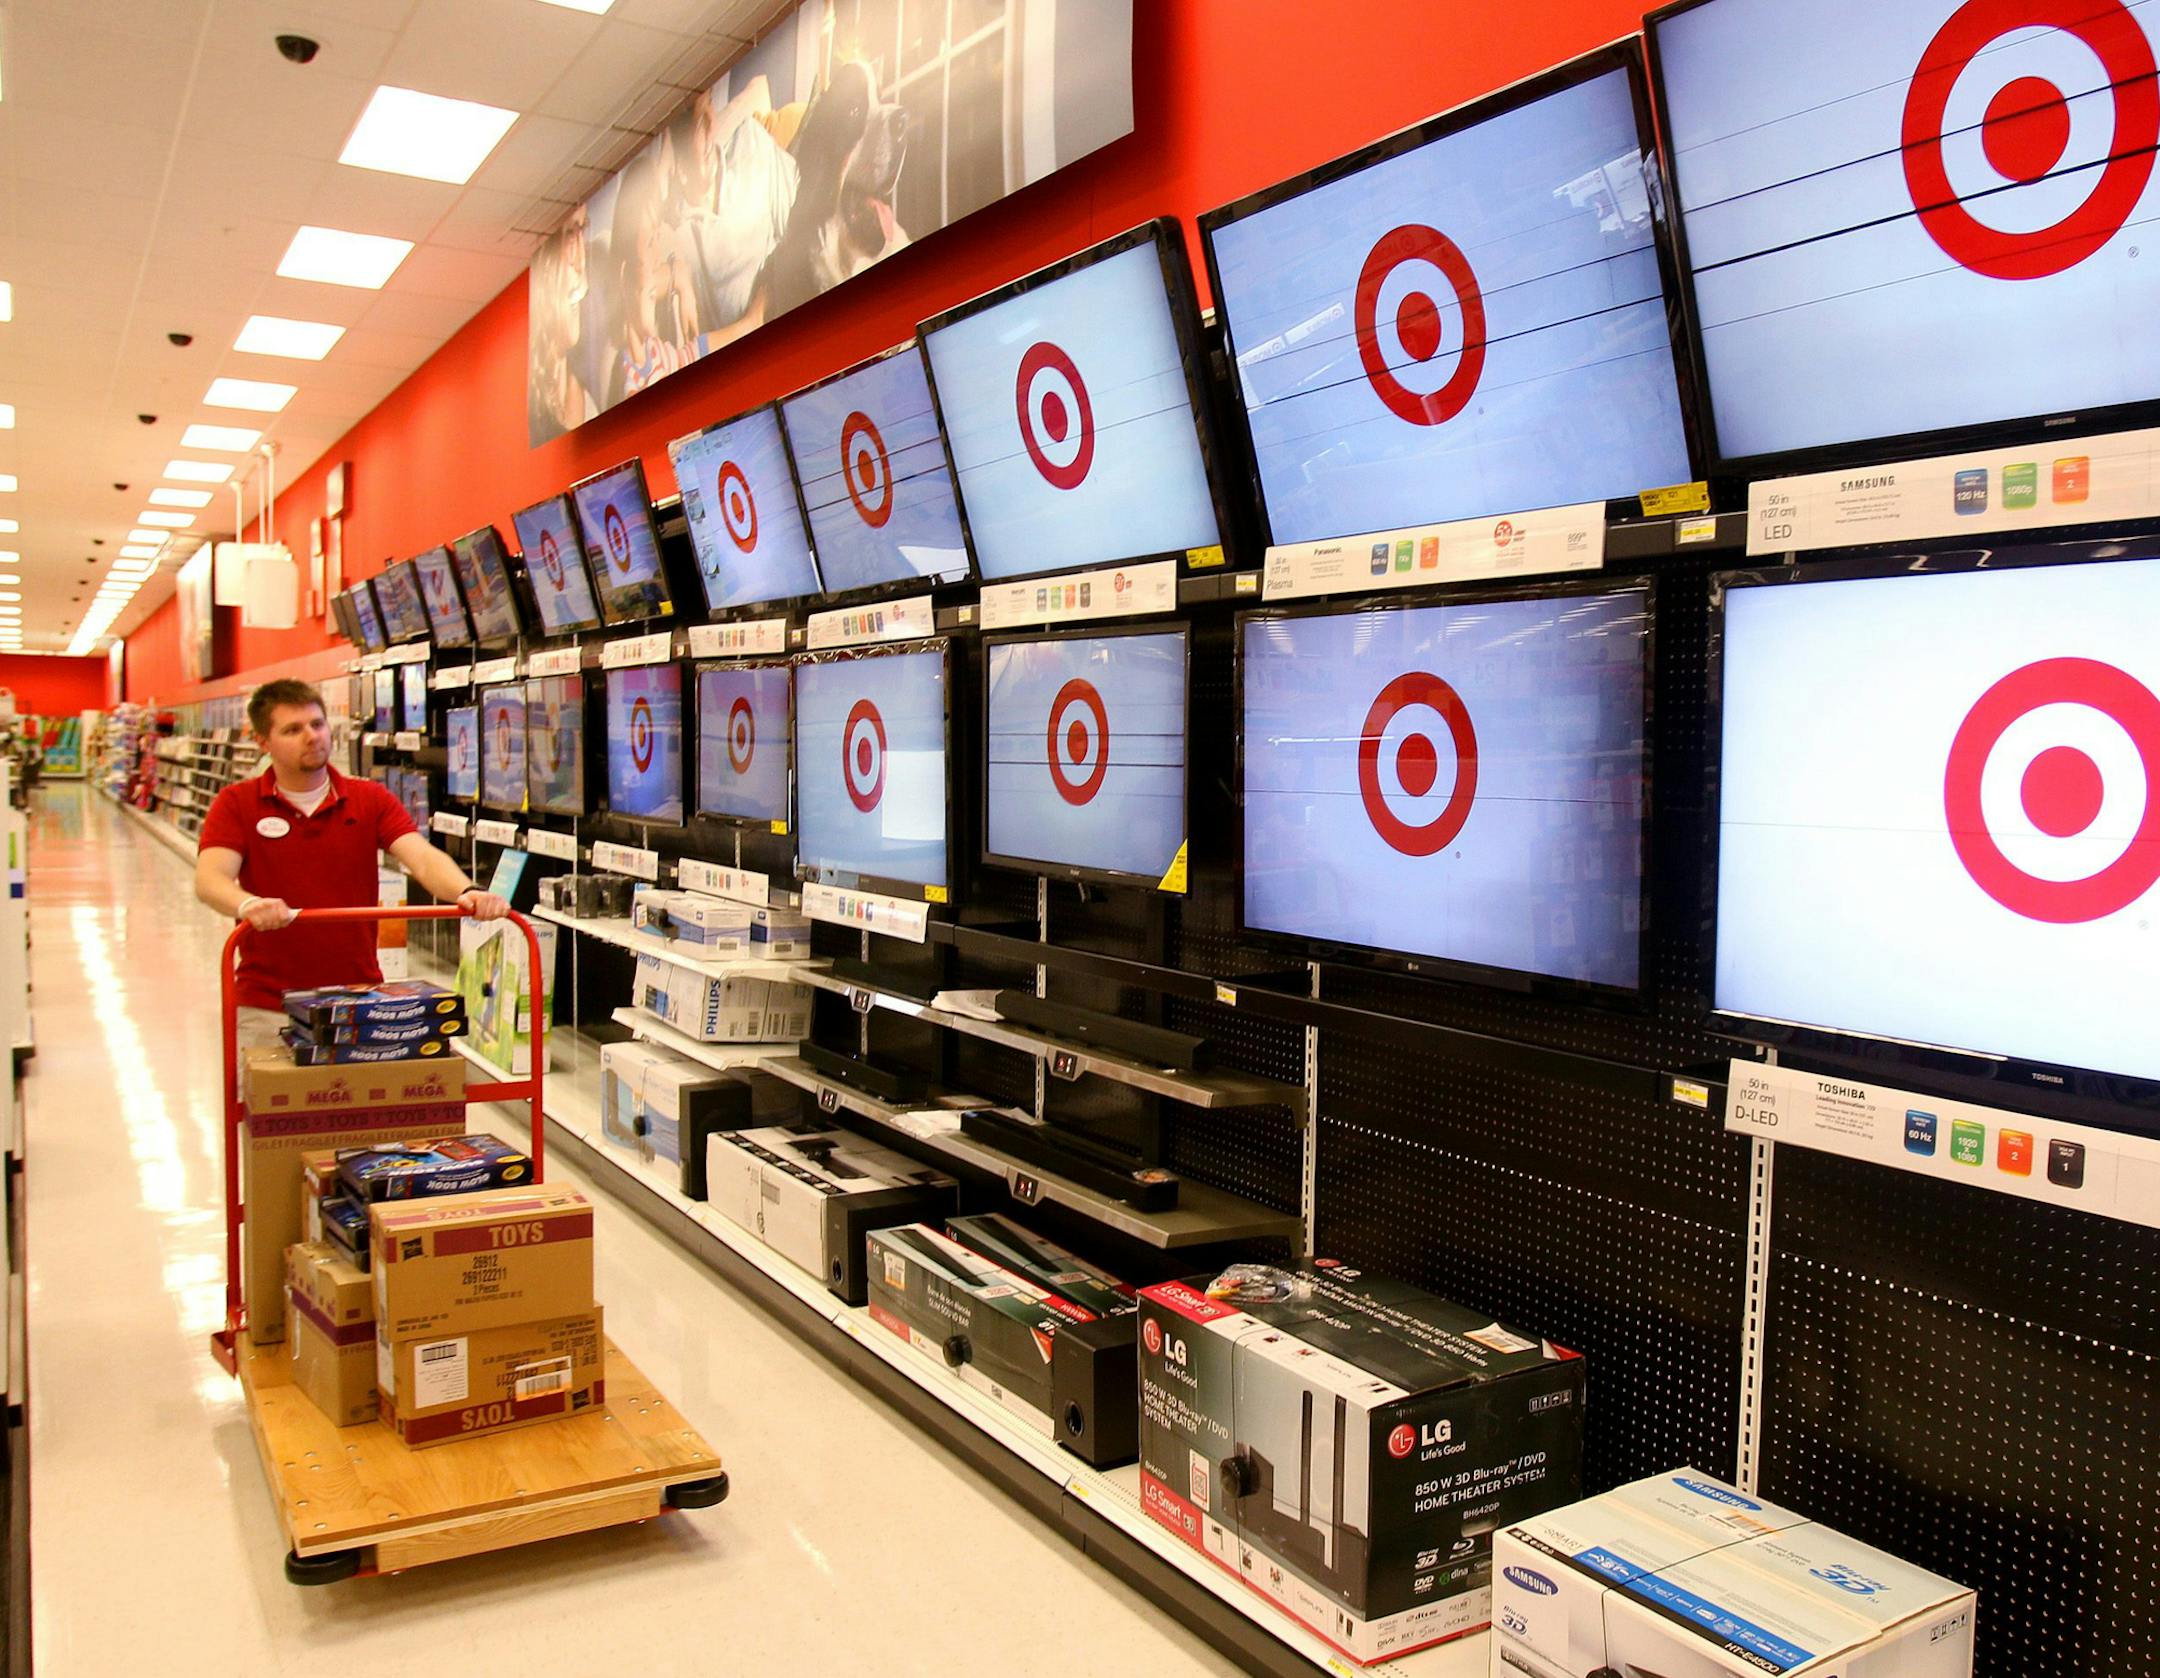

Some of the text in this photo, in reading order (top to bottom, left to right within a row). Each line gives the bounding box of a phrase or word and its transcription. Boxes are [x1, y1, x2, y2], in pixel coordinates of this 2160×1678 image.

[1840, 475, 1895, 492] SAMSUNG
[2006, 485, 2032, 496] 1080p
[1768, 494, 1790, 506] 50 in
[1956, 489, 1987, 501] 120 Hz
[1760, 506, 1797, 521] (127 cm)
[1764, 524, 1792, 540] LED
[1267, 578, 1293, 590] Plasma
[706, 979, 721, 1035] PHILIPS
[1748, 1077, 1769, 1090] 50 in
[2031, 1072, 2065, 1085] TOSHIBA
[308, 1091, 350, 1105] MEGA
[403, 1084, 445, 1097] MEGA
[1740, 1089, 1777, 1107] (127 cm)
[1817, 1081, 1866, 1101] TOSHIBA
[1815, 1094, 1837, 1106] Leading
[327, 1112, 369, 1128] TOYS
[1735, 1105, 1779, 1127] D-LED
[1908, 1129, 1932, 1143] 60 Hz
[1958, 1136, 1978, 1149] 1920
[1957, 1150, 1977, 1163] 1080
[2010, 1151, 2019, 1161] 2
[2063, 1162, 2069, 1172] 1
[426, 1172, 491, 1190] GLOW BOOK
[428, 1208, 484, 1220] TOYS
[489, 1222, 544, 1248] TOYS
[1333, 1265, 1362, 1277] LG
[1164, 1333, 1188, 1367] LG
[1164, 1361, 1198, 1390] Life's Good
[461, 1403, 515, 1430] TOYS
[1143, 1379, 1159, 1397] 850
[1158, 1386, 1168, 1400] W
[1166, 1392, 1177, 1408] 3D
[1211, 1423, 1229, 1441] DVD
[1143, 1393, 1198, 1436] HOME THEATER
[1144, 1405, 1172, 1432] SYSTEM
[1421, 1418, 1452, 1448] LG
[1421, 1441, 1467, 1461] Life's Good
[1415, 1481, 1439, 1497] 850
[1439, 1476, 1453, 1489] W
[1455, 1471, 1471, 1487] 3D
[1524, 1451, 1547, 1467] DVD
[1415, 1467, 1546, 1514] HOME THEATER SYSTEM
[1685, 1479, 1751, 1510] SAMSUNG
[1145, 1480, 1158, 1502] LG
[1157, 1490, 1181, 1520] Smart
[1463, 1501, 1501, 1520] BH6420P
[1415, 1554, 1439, 1570] 3D
[1414, 1574, 1435, 1588] DVD
[1450, 1566, 1469, 1580] dlna
[1508, 1565, 1553, 1598] SAMSUNG
[1809, 1567, 1876, 1596] 3D
[1503, 1605, 1529, 1625] Blu-ray
[1501, 1614, 1528, 1636] 3D
[1723, 1642, 1781, 1674] HT-E4500
